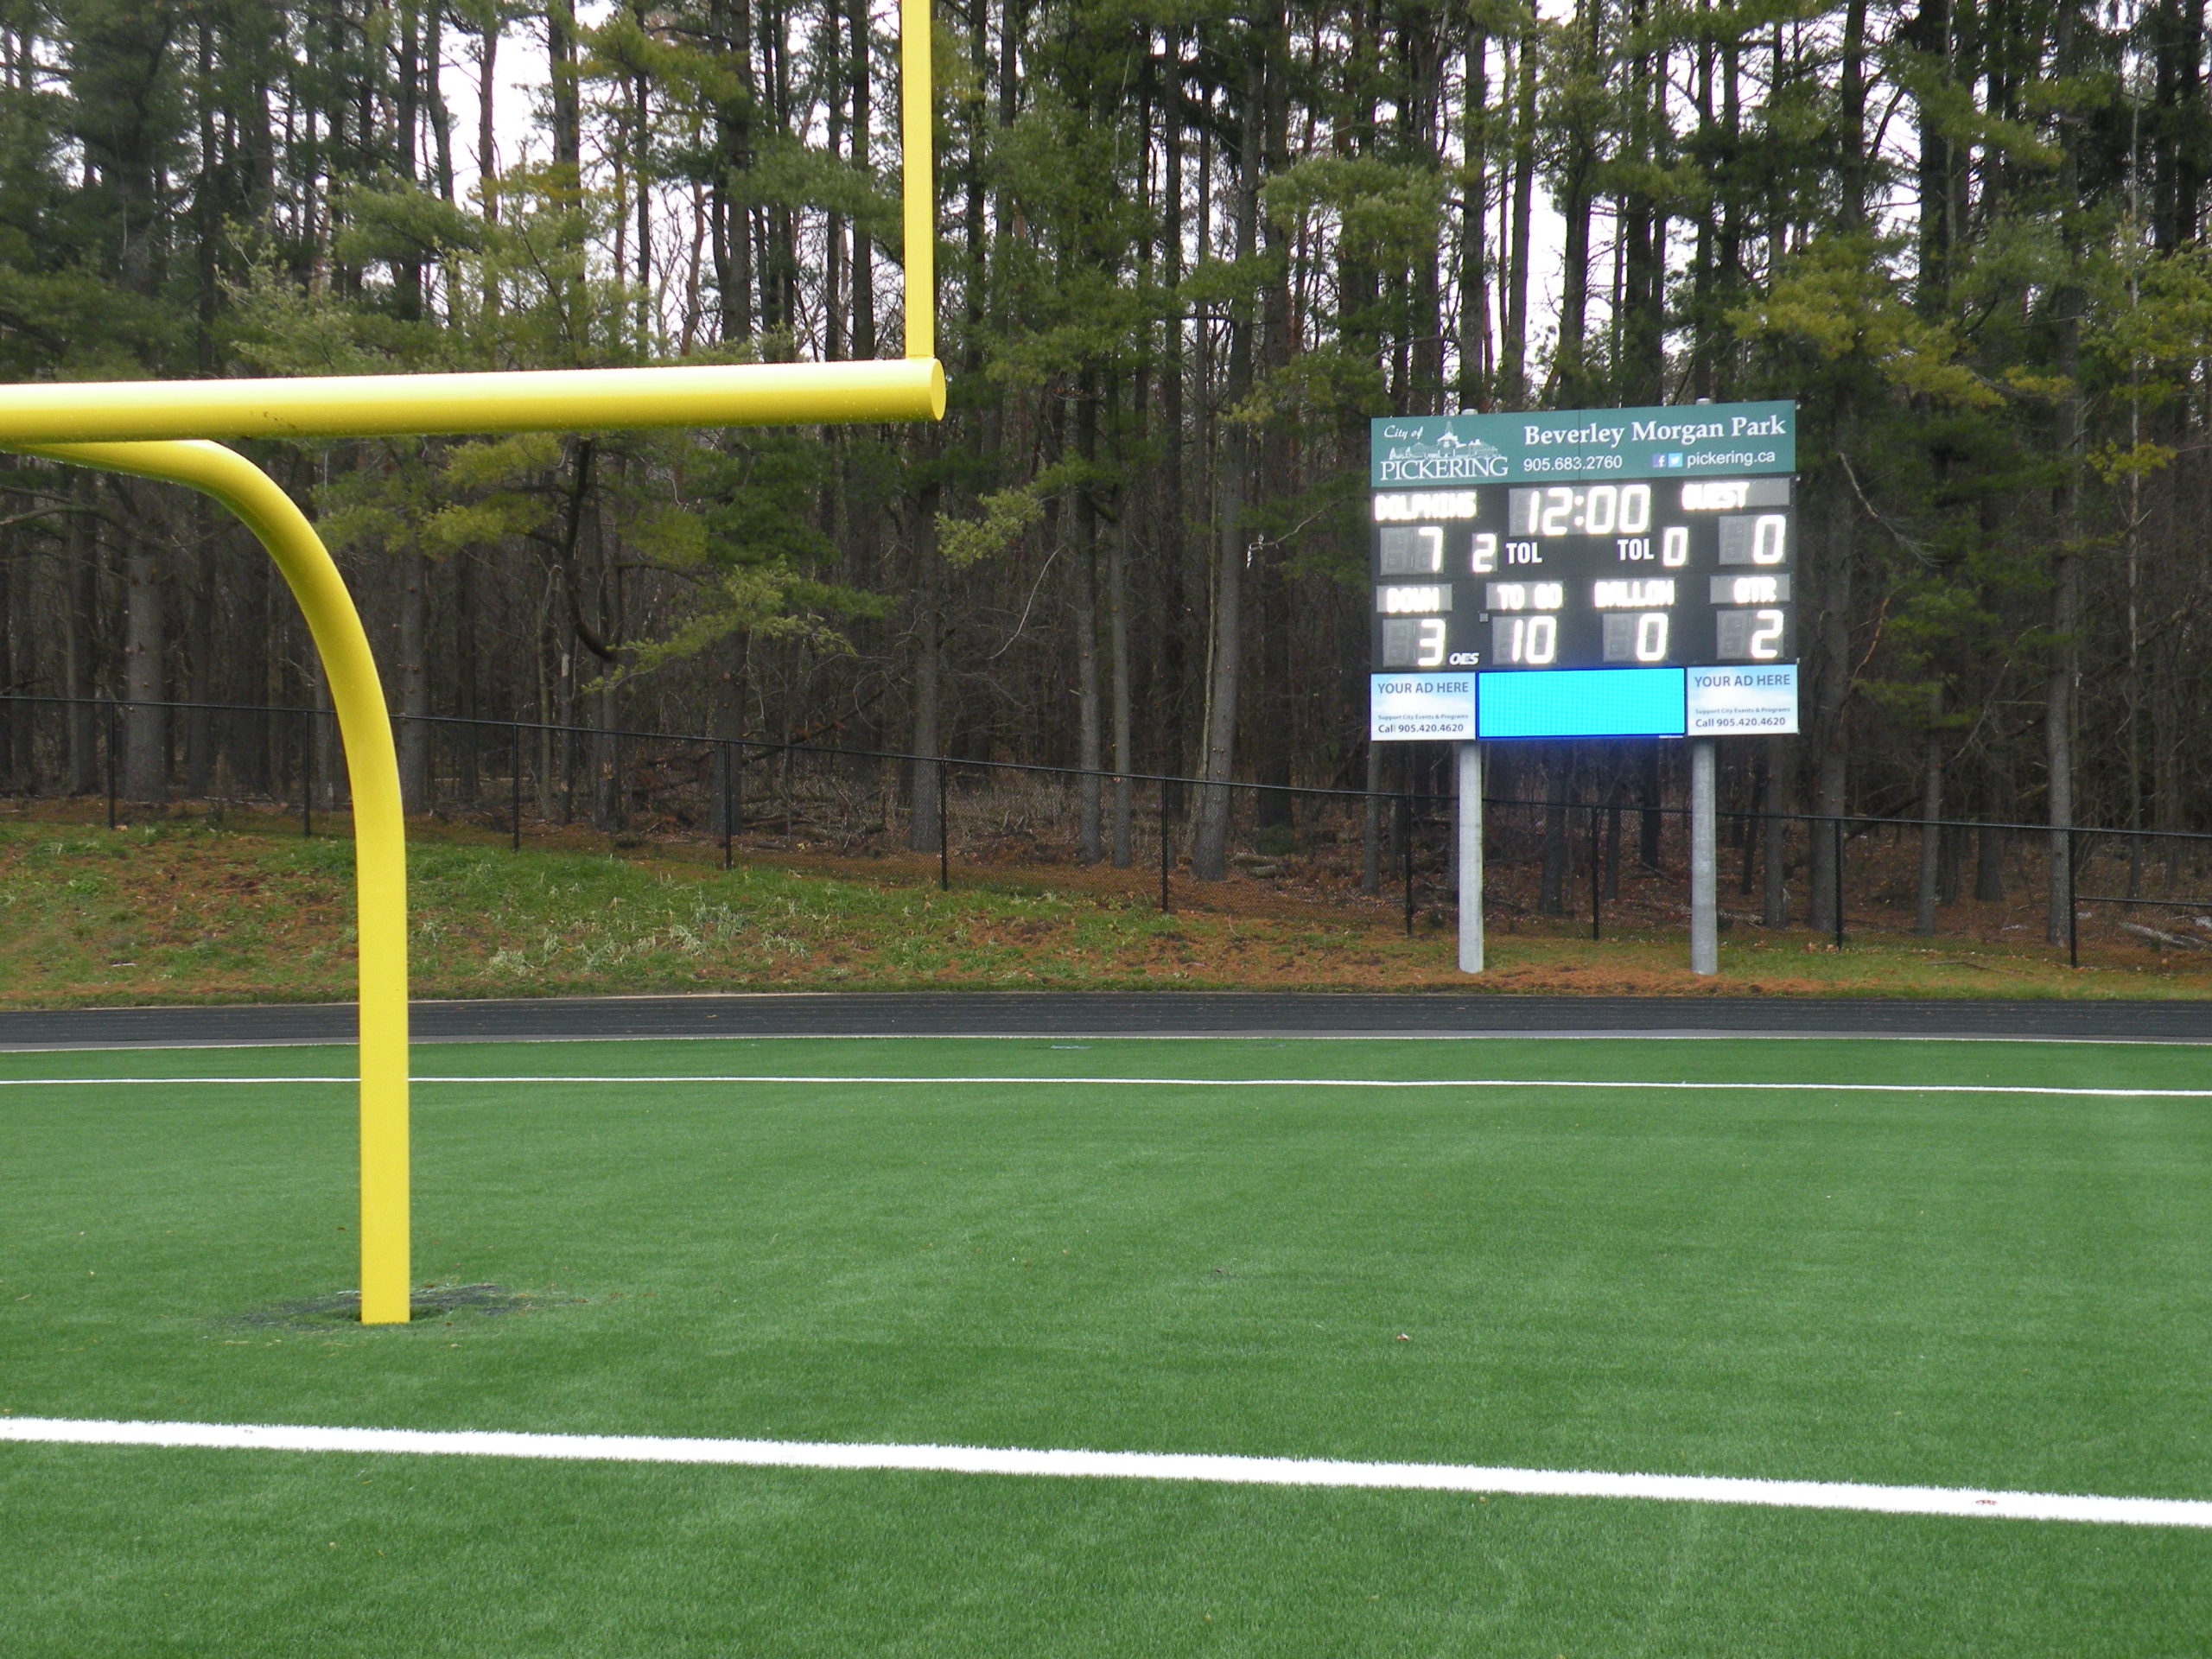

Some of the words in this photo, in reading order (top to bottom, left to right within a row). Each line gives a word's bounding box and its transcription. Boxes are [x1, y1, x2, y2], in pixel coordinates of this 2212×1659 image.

[1383, 425, 1408, 440] City
[1411, 426, 1423, 440] of
[1523, 422, 1624, 448] Beverley
[1631, 421, 1725, 444] Morgan
[1731, 414, 1786, 436] Park
[1380, 457, 1510, 480] PICKERING
[1522, 454, 1623, 472] 905.683.2760
[1687, 450, 1776, 468] pickering.ca
[1529, 485, 1651, 536] 12:00
[1418, 526, 1443, 571] 7
[1618, 538, 1654, 561] TOL
[1663, 526, 1688, 566] 0
[1753, 514, 1786, 564] 0
[1472, 533, 1497, 572] 2
[1506, 543, 1542, 563] TOL
[1387, 587, 1440, 613] DOWN
[1497, 585, 1524, 610] TO
[1418, 619, 1446, 666] 3
[1512, 616, 1556, 664] 10
[1637, 613, 1669, 662] 0
[1751, 609, 1783, 658] 2
[1449, 652, 1479, 665] OES
[1378, 683, 1412, 694] YOUR
[1416, 683, 1433, 693] AD
[1437, 682, 1468, 692] HERE
[1694, 676, 1731, 687] YOUR
[1734, 676, 1752, 686] AD
[1757, 675, 1790, 685] HERE
[1717, 717, 1786, 726] 905.420.4620
